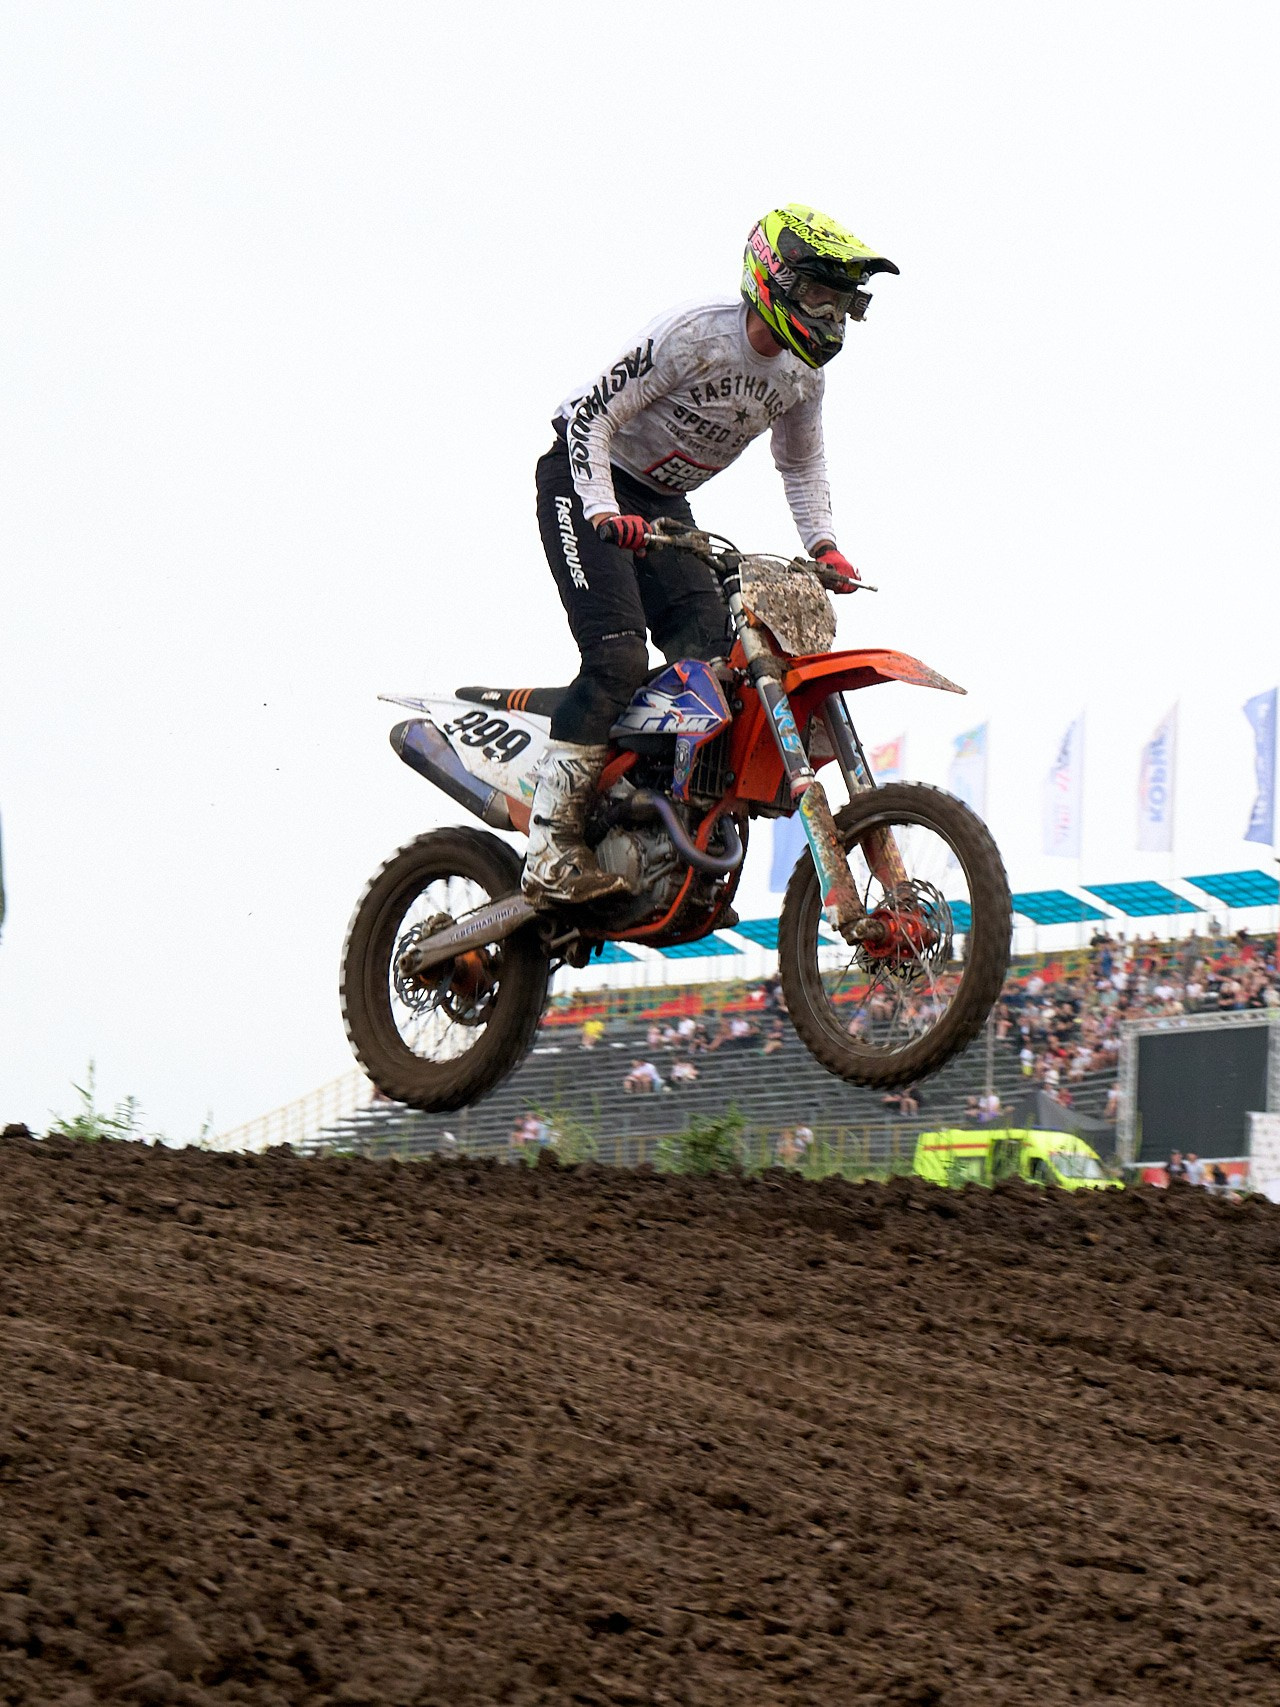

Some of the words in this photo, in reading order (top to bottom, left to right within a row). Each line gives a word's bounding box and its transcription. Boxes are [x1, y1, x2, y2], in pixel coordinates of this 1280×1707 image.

[570, 338, 655, 481] FASTHOUSE
[672, 405, 731, 443] SPEED
[554, 495, 590, 591] FASTHOUSE
[443, 711, 532, 763] 999
